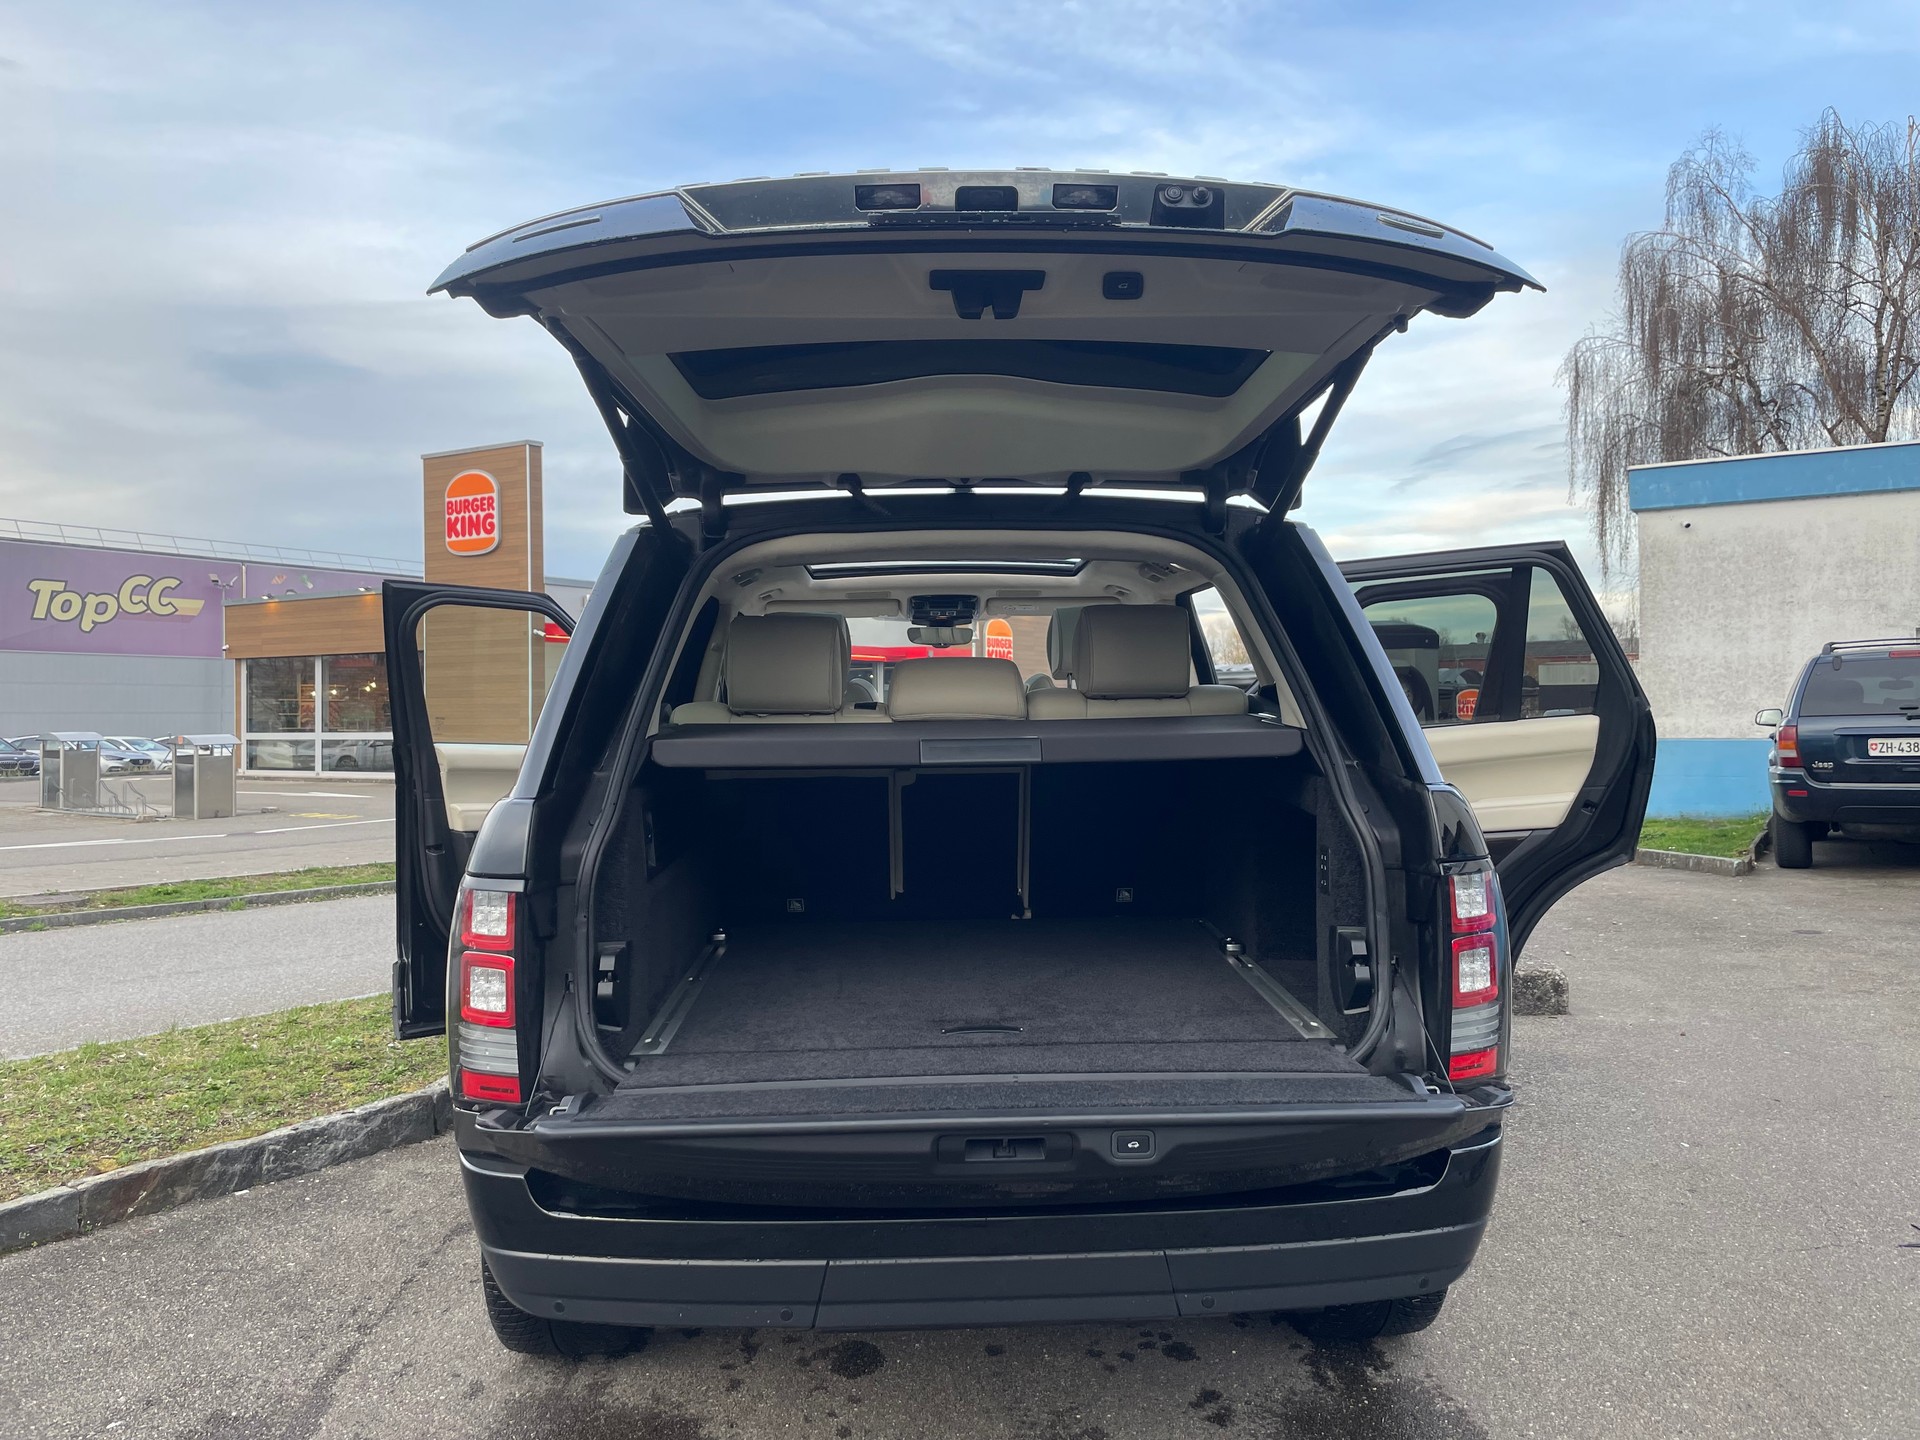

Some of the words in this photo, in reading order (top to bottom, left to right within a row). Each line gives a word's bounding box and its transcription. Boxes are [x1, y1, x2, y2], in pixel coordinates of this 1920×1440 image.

[446, 495, 496, 516] BURGER
[446, 512, 496, 539] KING
[986, 637, 1013, 649] BURGER
[1811, 760, 1834, 769] Jeep
